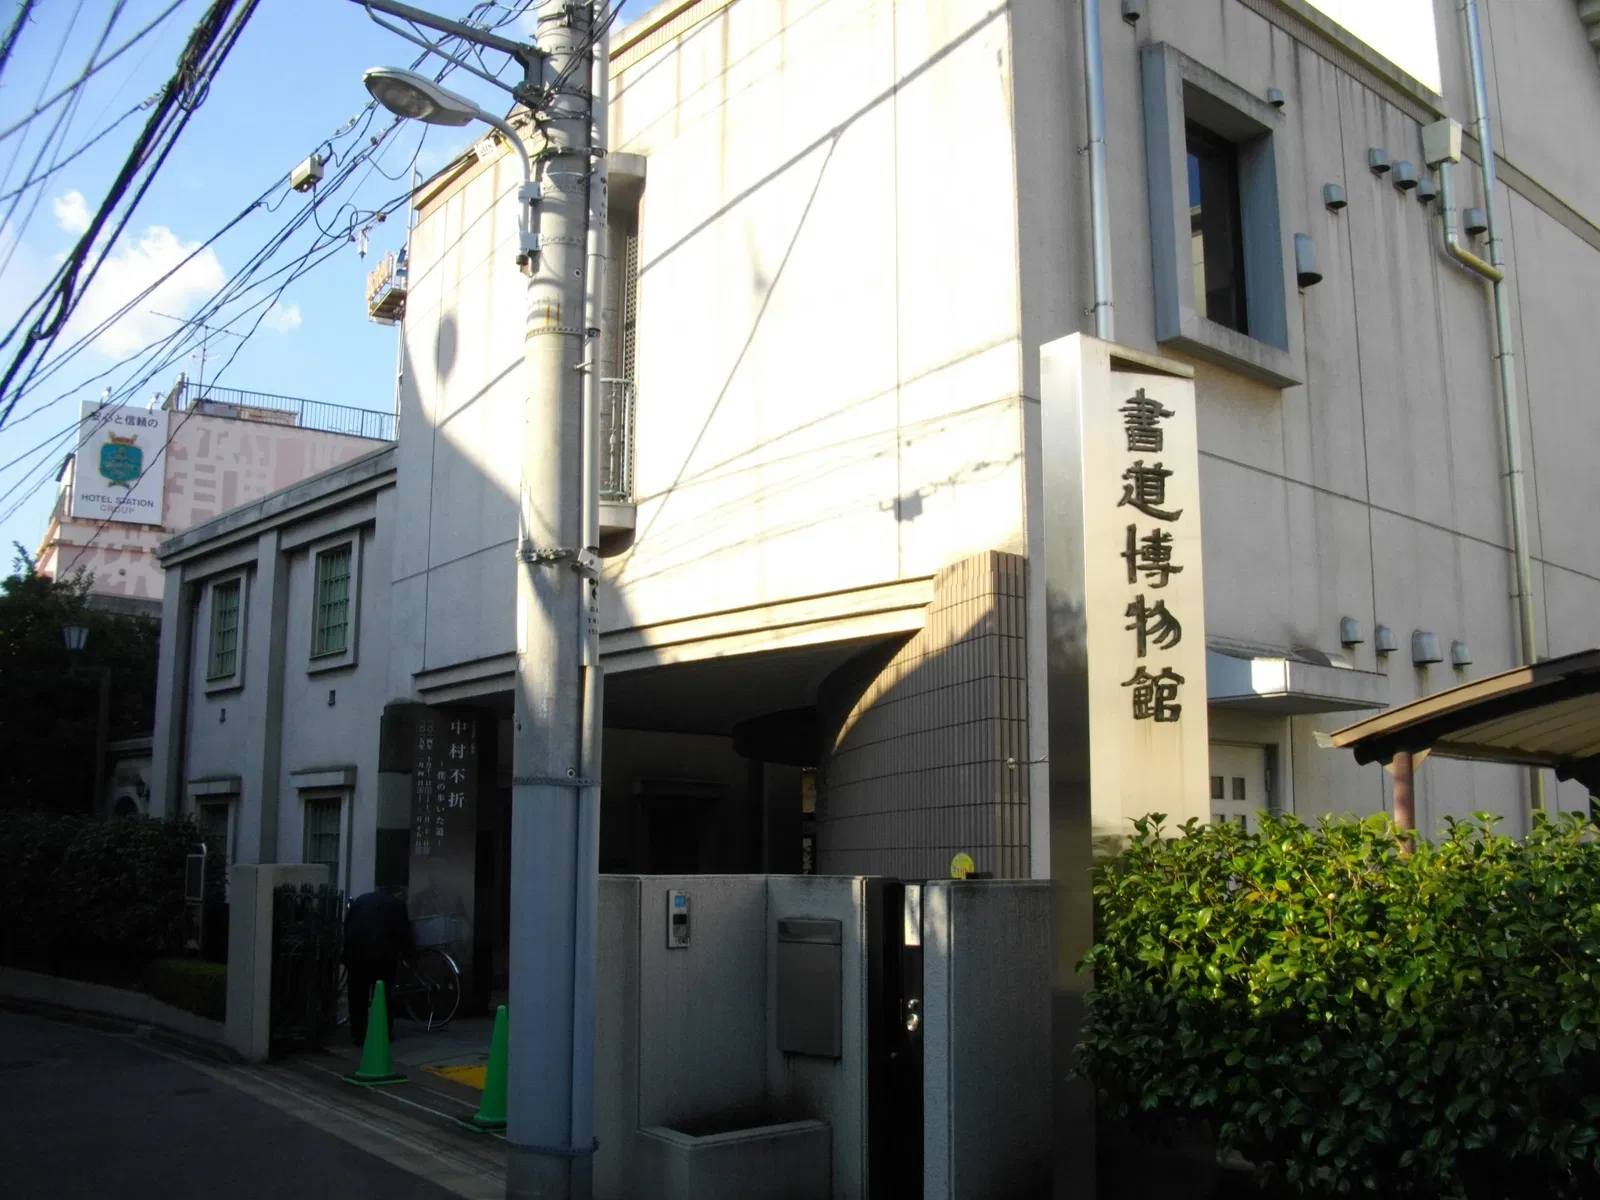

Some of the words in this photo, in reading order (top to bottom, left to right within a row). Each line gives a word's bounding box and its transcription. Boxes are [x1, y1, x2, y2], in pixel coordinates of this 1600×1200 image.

[81, 493, 112, 504] HOTEL
[115, 496, 154, 508] STATION
[99, 504, 135, 514] GROUP
[1116, 387, 1186, 724] 書道博物館
[448, 719, 467, 809] 中村不折
